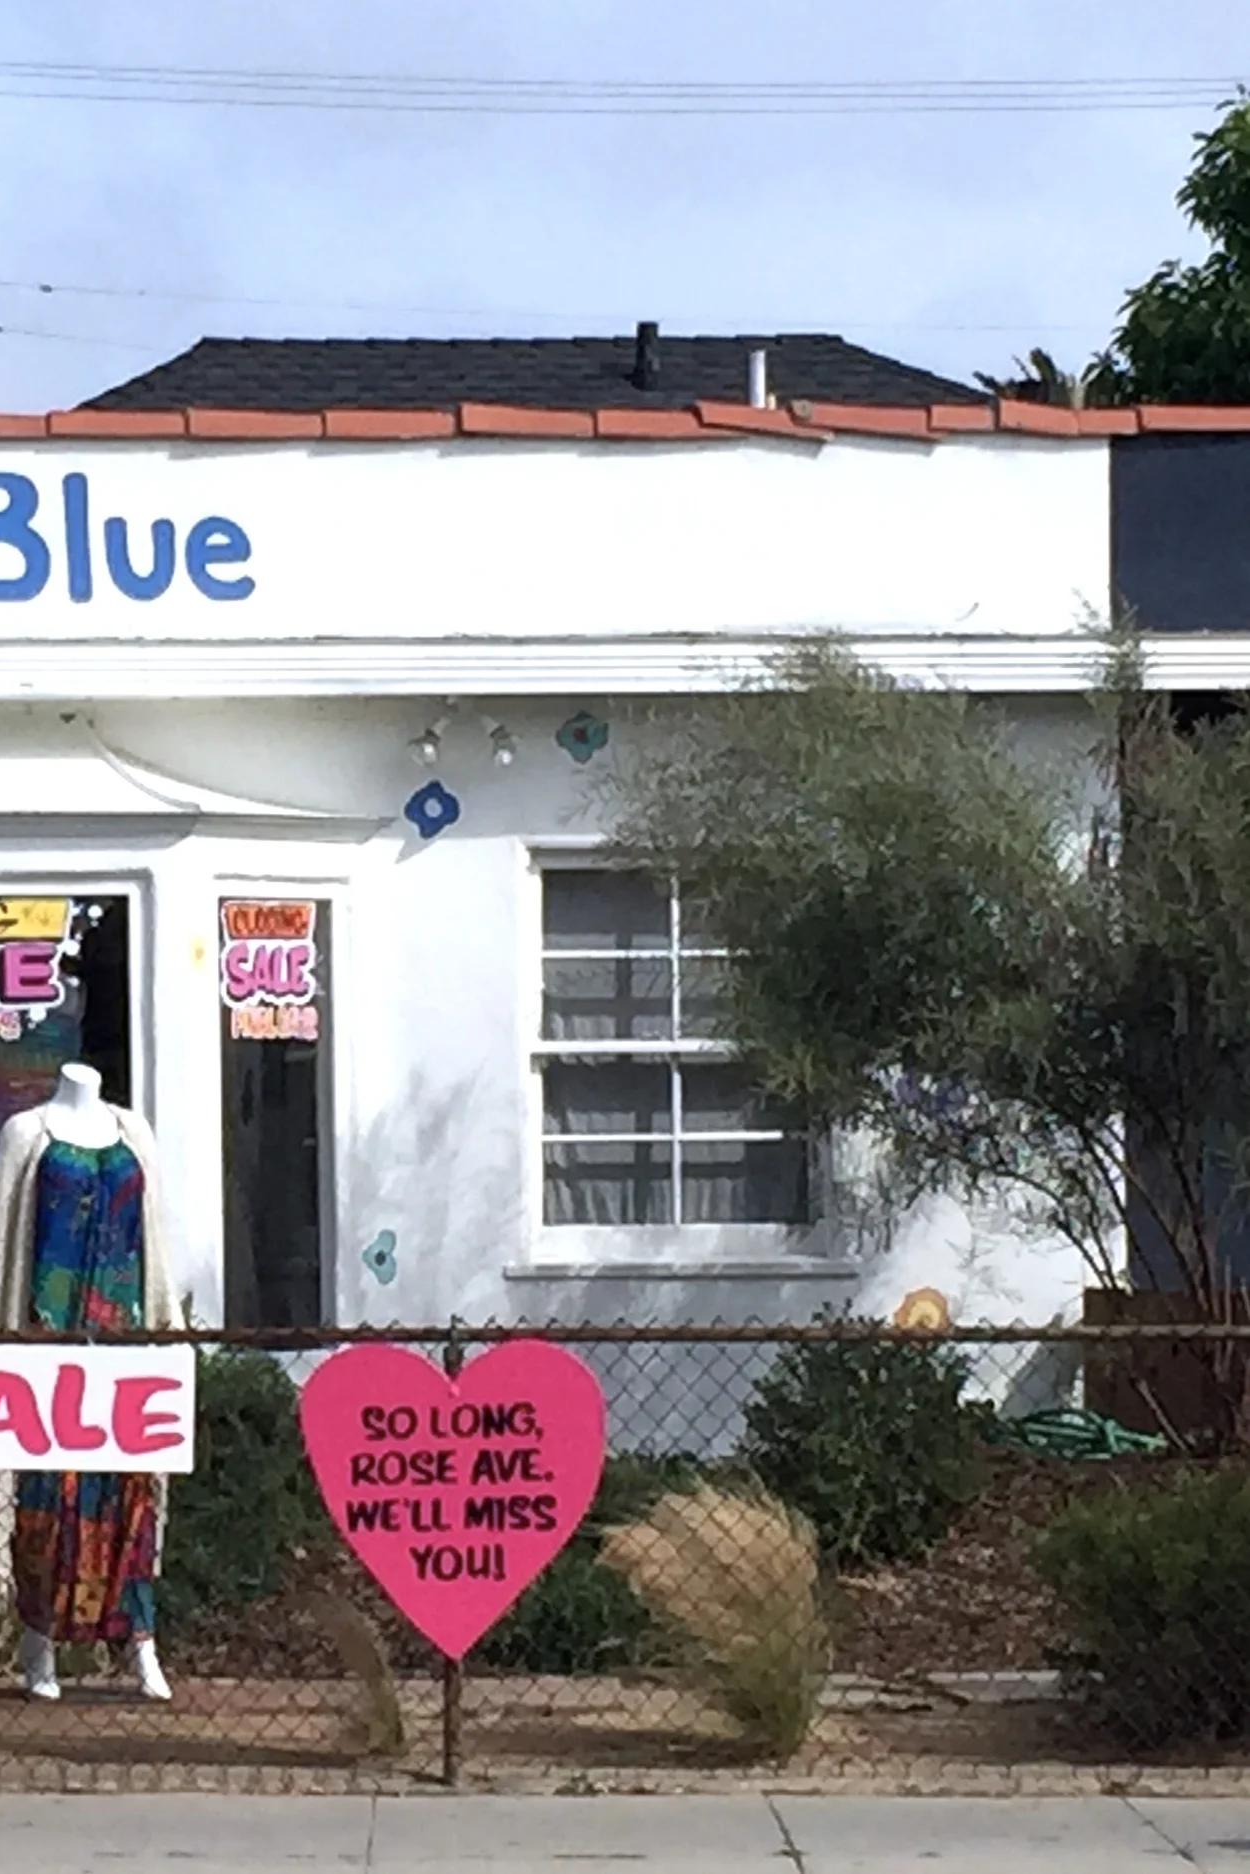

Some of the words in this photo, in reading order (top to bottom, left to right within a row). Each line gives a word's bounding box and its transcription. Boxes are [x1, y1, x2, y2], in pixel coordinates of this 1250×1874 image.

[225, 941, 311, 1002] SALE
[361, 1405, 418, 1441] SO
[430, 1402, 544, 1440] LONG,
[350, 1450, 458, 1486] ROSE
[471, 1449, 554, 1485] AVE.
[346, 1497, 452, 1533] WE'LL
[464, 1495, 557, 1533] MISS
[409, 1543, 506, 1581] YOU!
